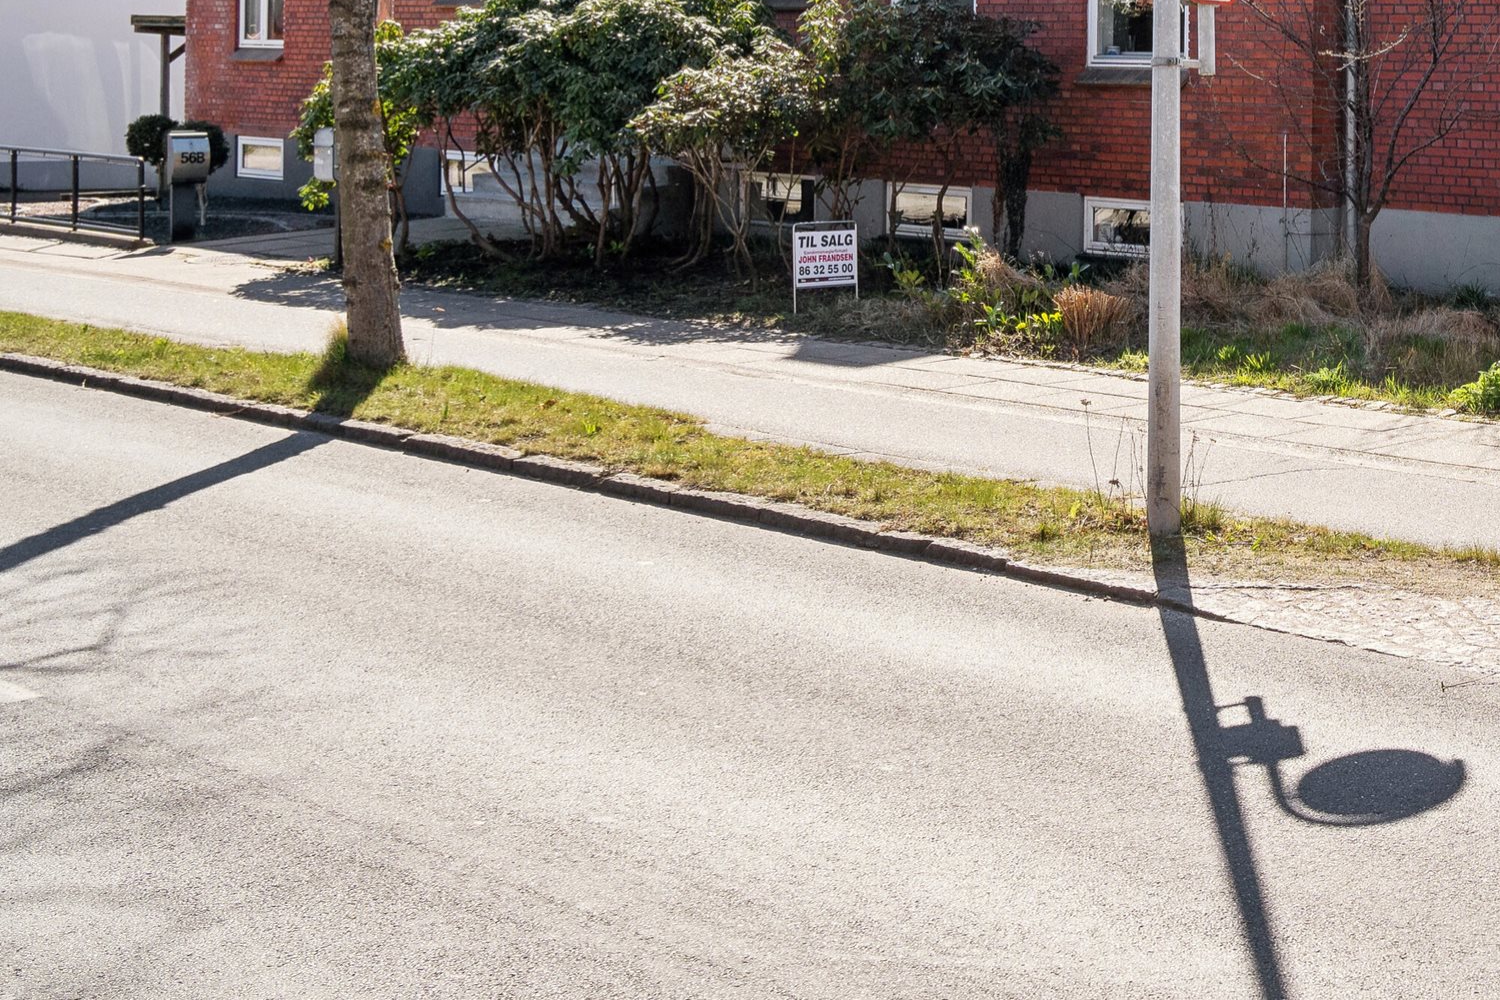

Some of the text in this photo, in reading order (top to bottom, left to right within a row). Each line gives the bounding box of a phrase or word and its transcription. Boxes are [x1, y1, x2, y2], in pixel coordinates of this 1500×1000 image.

[798, 233, 853, 248] TIL SALG
[798, 253, 854, 264] JOHN FRANDSEN
[798, 263, 853, 276] 86 32 55 00
